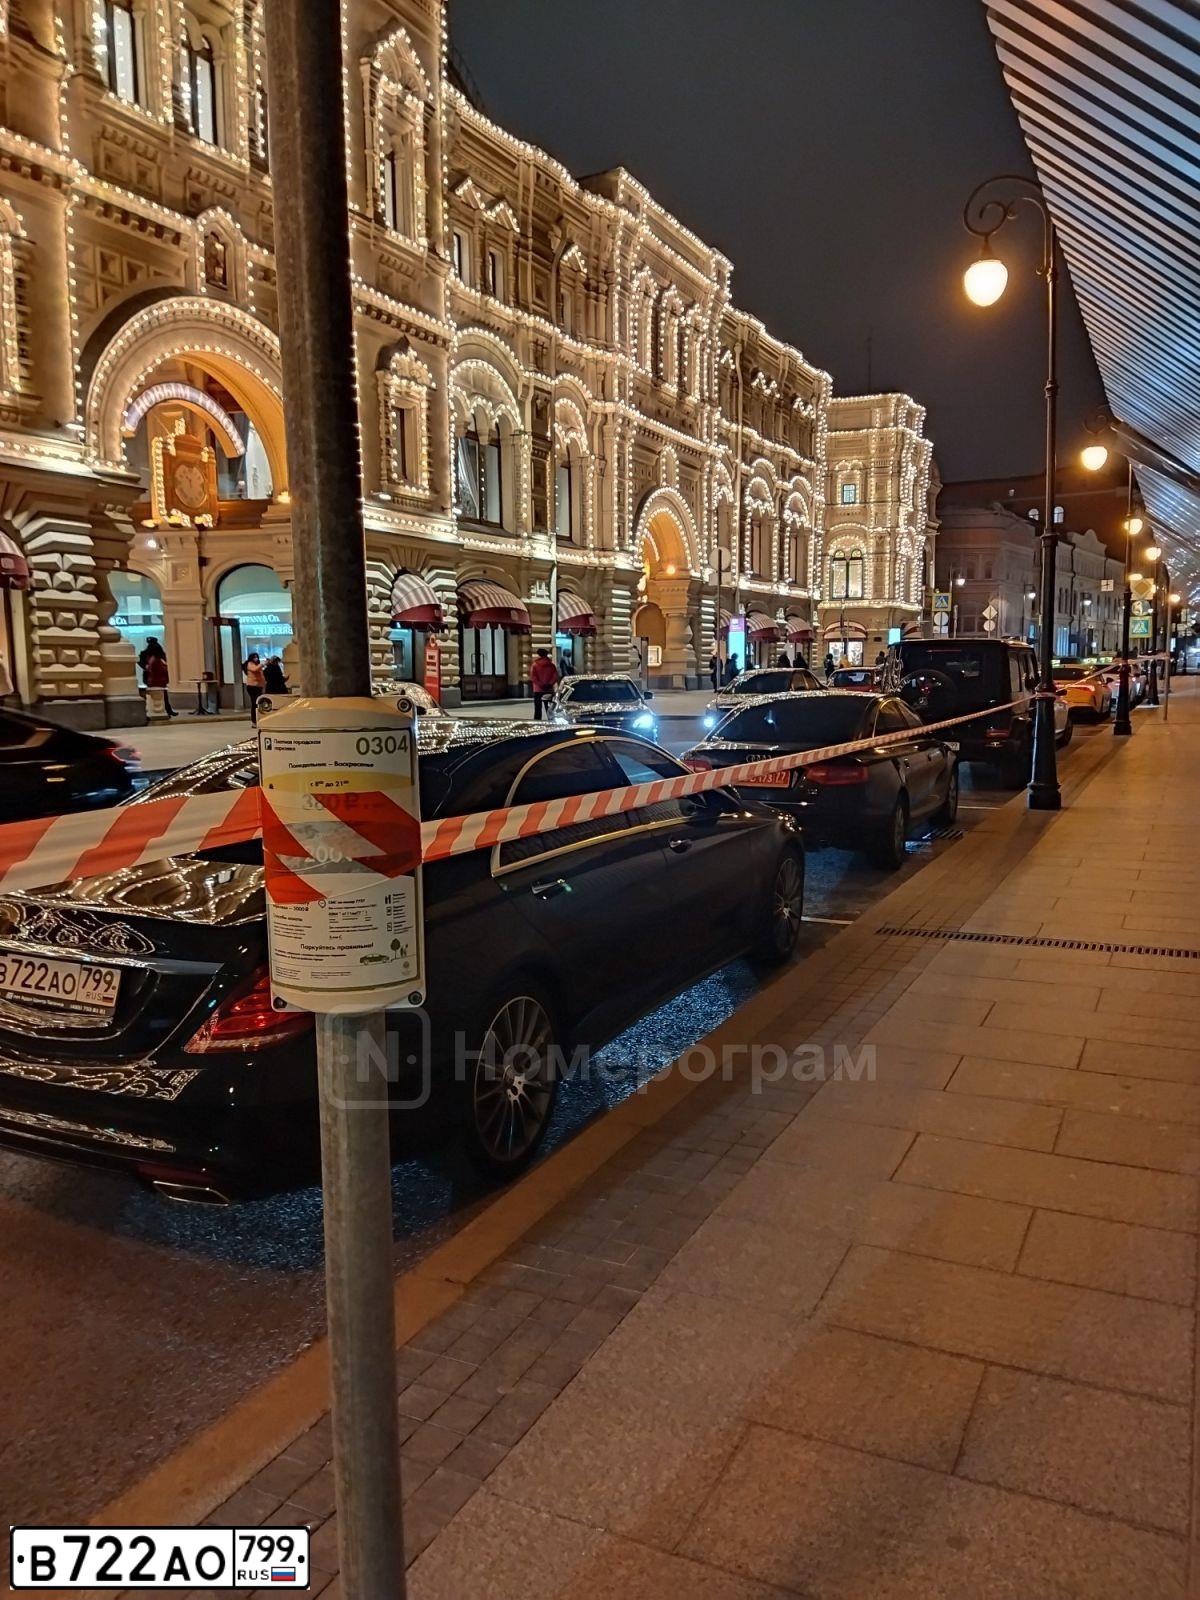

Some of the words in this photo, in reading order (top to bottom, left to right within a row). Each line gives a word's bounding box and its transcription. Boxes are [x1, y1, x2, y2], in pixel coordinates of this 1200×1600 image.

[355, 735, 409, 756] 0304
[301, 943, 335, 951] Паркуйтесь
[82, 967, 115, 993] 799
[86, 991, 102, 1001] RUS
